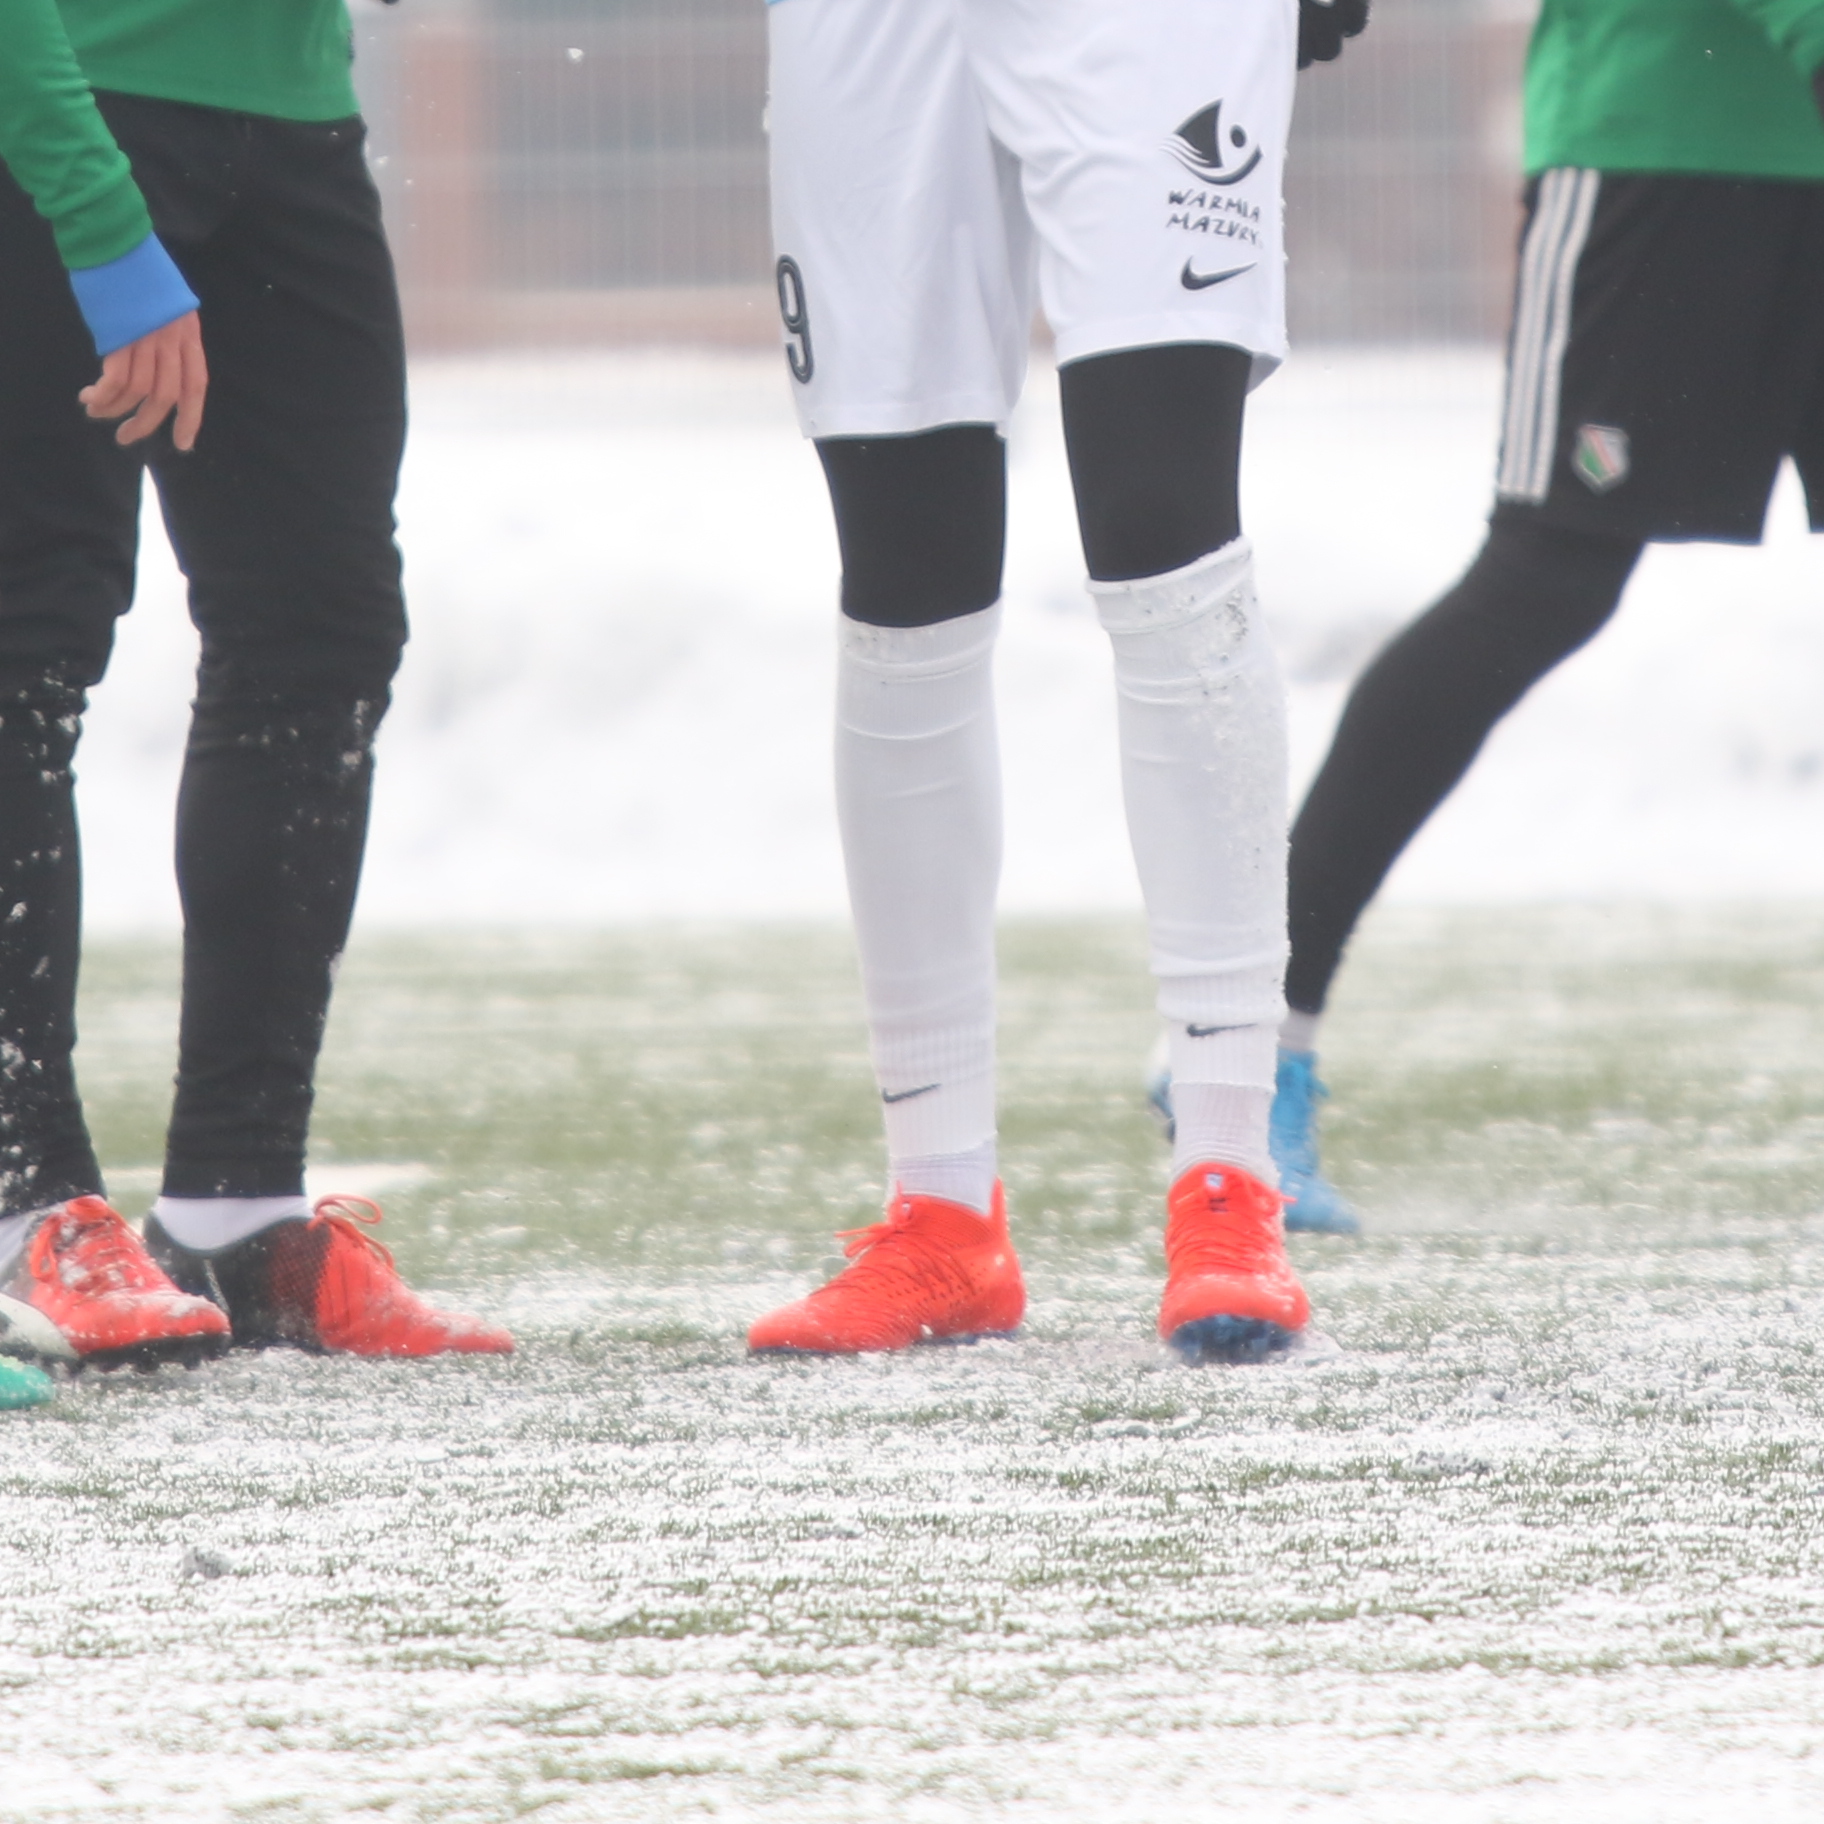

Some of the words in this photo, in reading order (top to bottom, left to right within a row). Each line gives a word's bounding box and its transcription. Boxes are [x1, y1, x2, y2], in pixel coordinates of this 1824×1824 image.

[1168, 188, 1261, 223] WARMIA
[1165, 211, 1260, 246] MAZURY
[777, 255, 813, 384] 9
